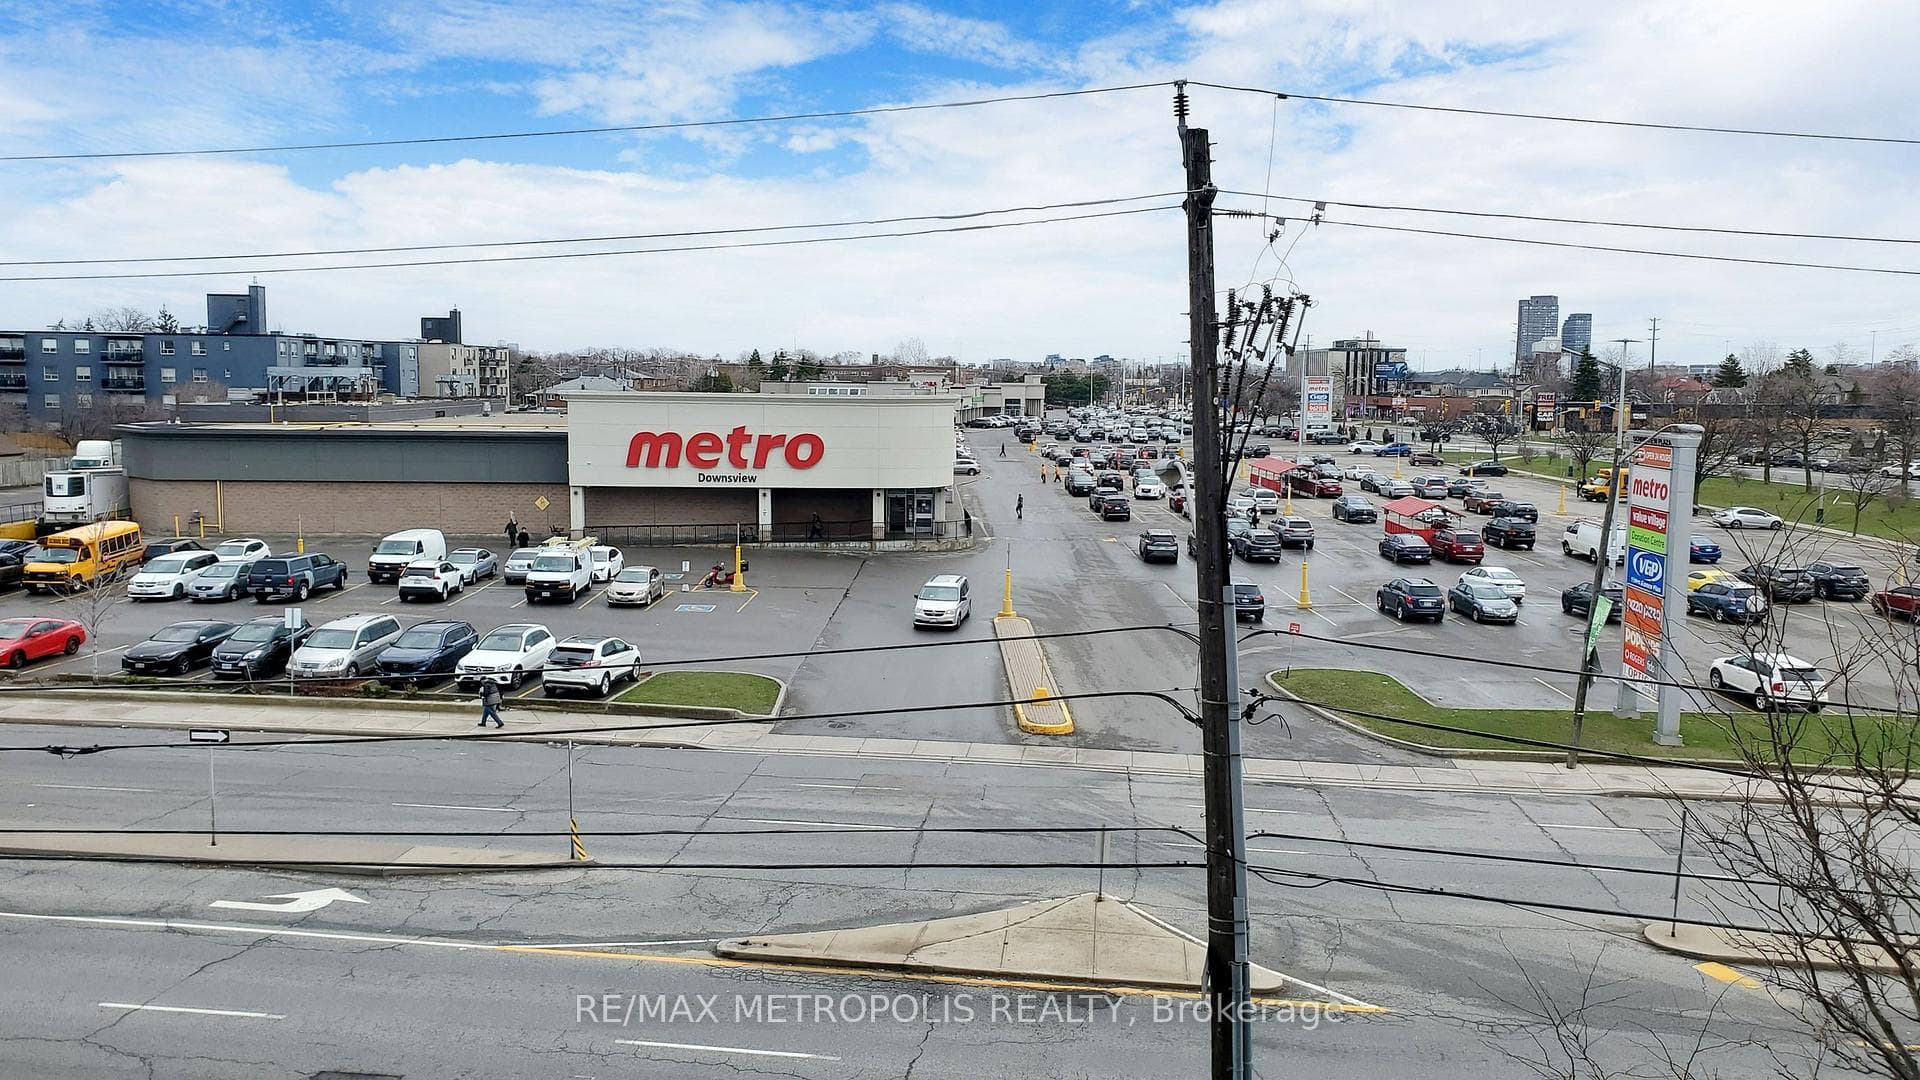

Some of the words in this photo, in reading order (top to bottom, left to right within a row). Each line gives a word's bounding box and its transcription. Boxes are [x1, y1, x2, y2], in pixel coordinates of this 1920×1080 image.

[625, 424, 825, 470] metro
[698, 473, 757, 483] Downsview
[1632, 478, 1668, 501] metro
[1632, 511, 1647, 524] value
[1648, 512, 1666, 530] village
[1631, 530, 1650, 544] Donation
[1650, 536, 1665, 549] Centre
[1639, 557, 1659, 577] VGP
[1626, 598, 1643, 613] pizza
[1643, 604, 1661, 621] pizza
[1629, 652, 1645, 667] ROGERS
